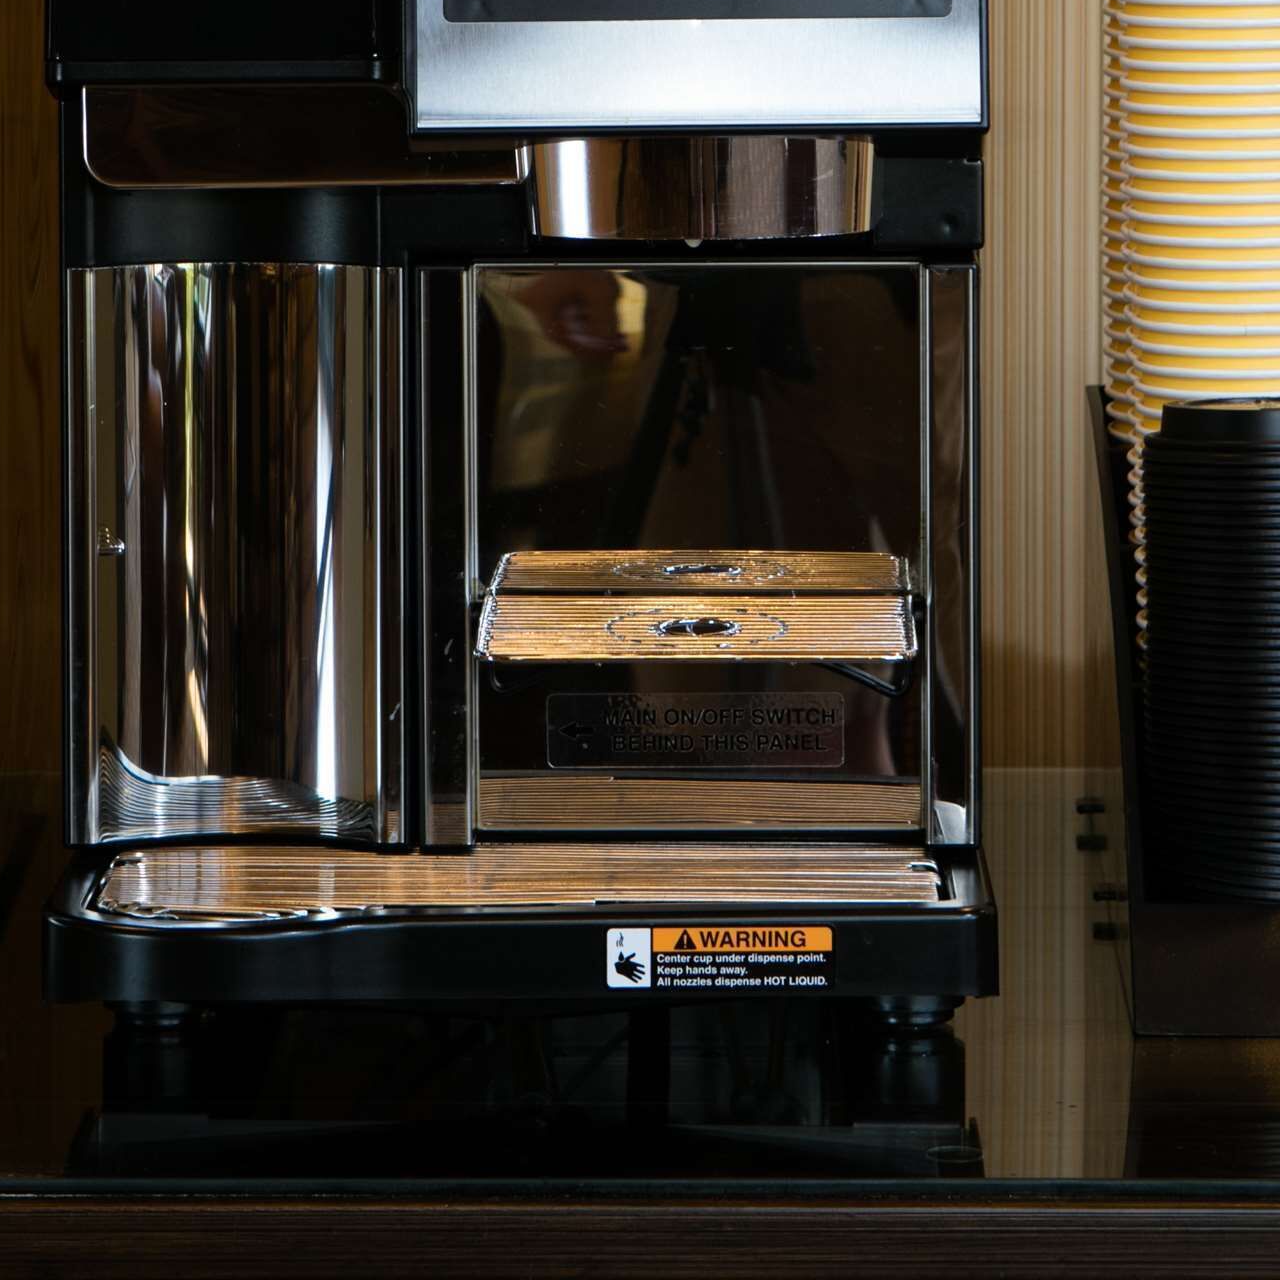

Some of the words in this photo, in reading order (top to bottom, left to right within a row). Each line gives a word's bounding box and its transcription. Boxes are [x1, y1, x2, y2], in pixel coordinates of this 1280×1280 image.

[605, 708, 656, 726] MAIN
[664, 708, 744, 726] ON/OFF
[752, 708, 835, 725] SWITCH
[612, 734, 694, 751] BEHIND
[702, 734, 750, 751] THIS
[756, 734, 828, 751] PANEL
[700, 930, 806, 948] WARNING
[657, 954, 690, 963] Center
[693, 956, 713, 965] cup
[715, 954, 745, 963] under
[748, 953, 794, 964] dispense
[797, 953, 827, 964] point.
[657, 966, 683, 976] Keep
[686, 966, 717, 975] hands
[720, 967, 748, 977] away.
[657, 977, 671, 986] All
[673, 977, 712, 986] nozzles
[715, 977, 761, 988] dispense
[764, 976, 786, 986] HOT
[789, 976, 828, 987] LIQUID.
